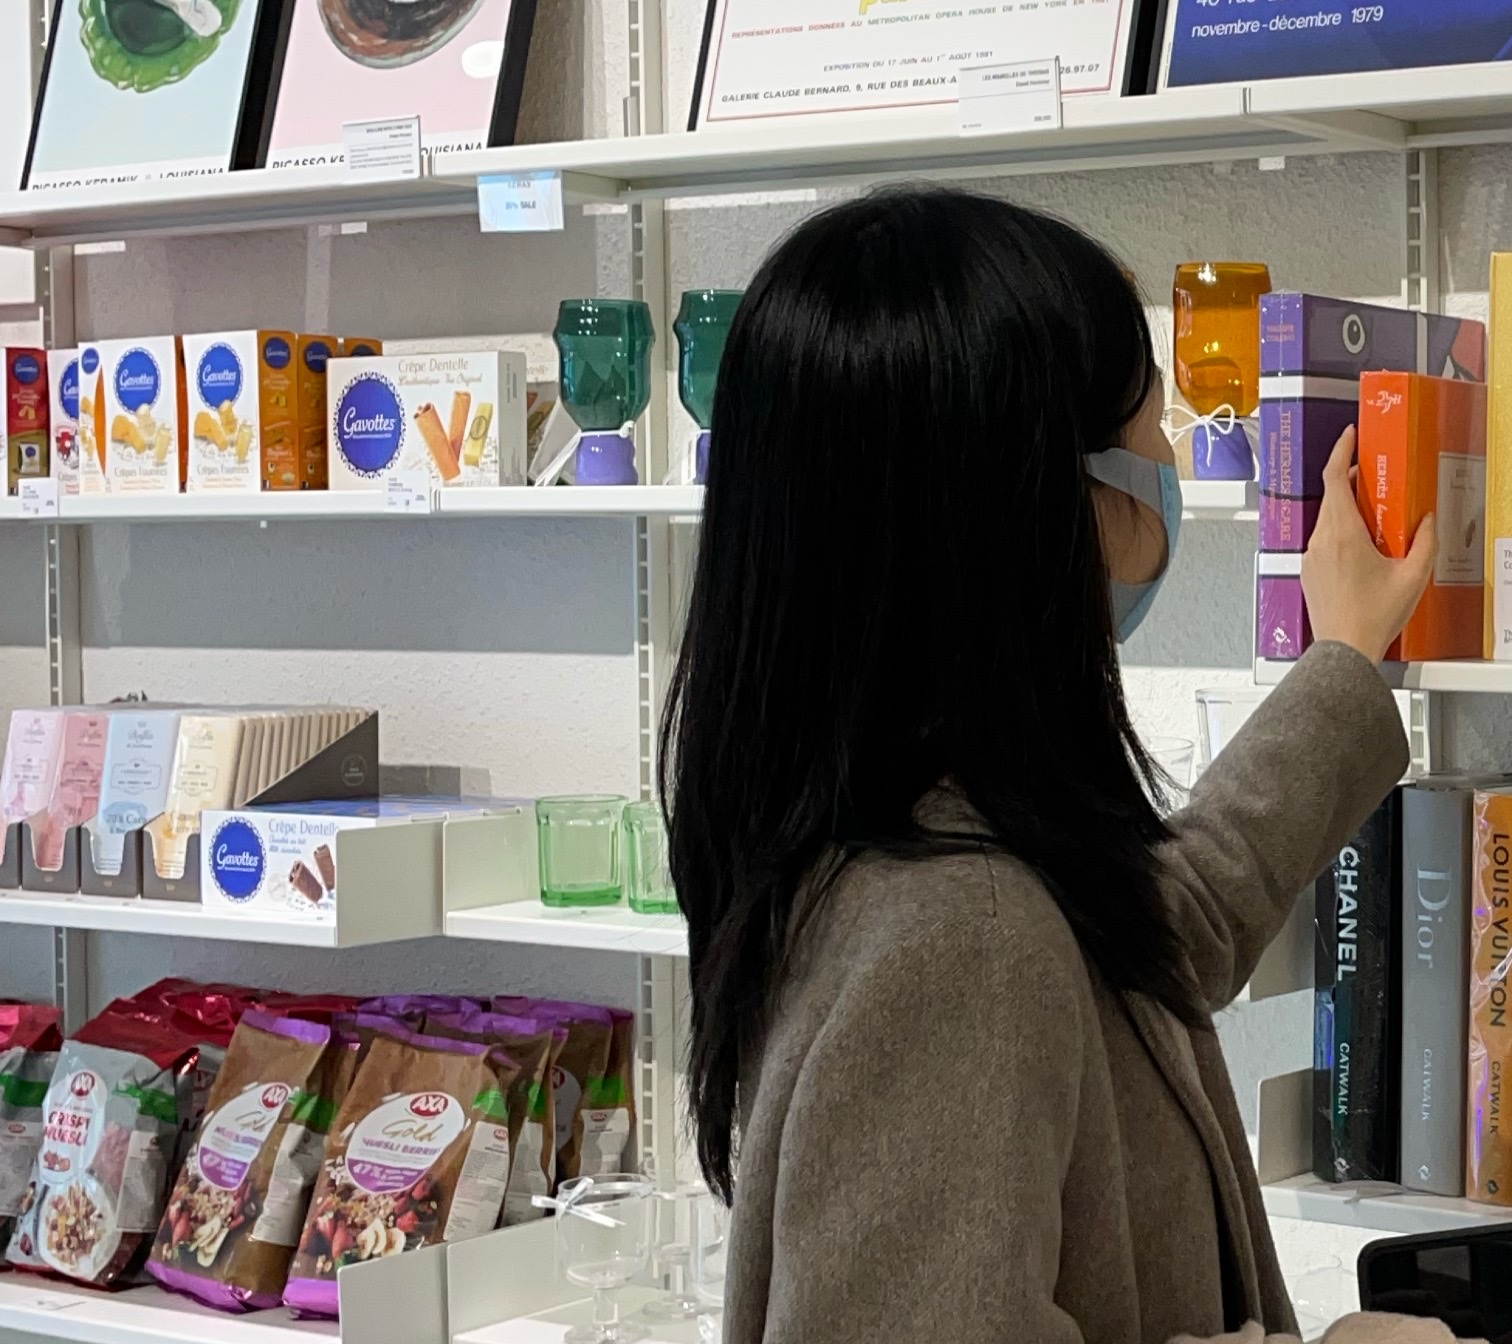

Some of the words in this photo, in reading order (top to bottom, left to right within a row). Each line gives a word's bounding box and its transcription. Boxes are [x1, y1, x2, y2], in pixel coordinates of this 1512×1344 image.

[1019, 1, 1039, 12] NEW
[1350, 5, 1384, 25] 1979
[721, 92, 760, 103] GALERIE
[763, 88, 801, 100] CLAUDE
[867, 81, 888, 92] RUE
[890, 79, 910, 90] DES
[203, 364, 237, 385] Gavottes
[398, 358, 427, 374] Crêpe
[429, 357, 469, 371] Dentelle
[120, 369, 154, 389] Gavottes
[343, 407, 396, 438] Gavottes
[268, 819, 296, 835] Crêpe
[216, 843, 259, 869] Gavottes
[1491, 833, 1510, 908] LOUIS
[1338, 846, 1360, 982] CHANEL
[1416, 868, 1453, 969] Dior
[1338, 1042, 1349, 1116] CATWALK
[1421, 1048, 1433, 1121] CATWALK
[412, 1095, 444, 1112] AXA
[1489, 1061, 1501, 1135] CATWALK
[381, 1119, 444, 1142] Gold
